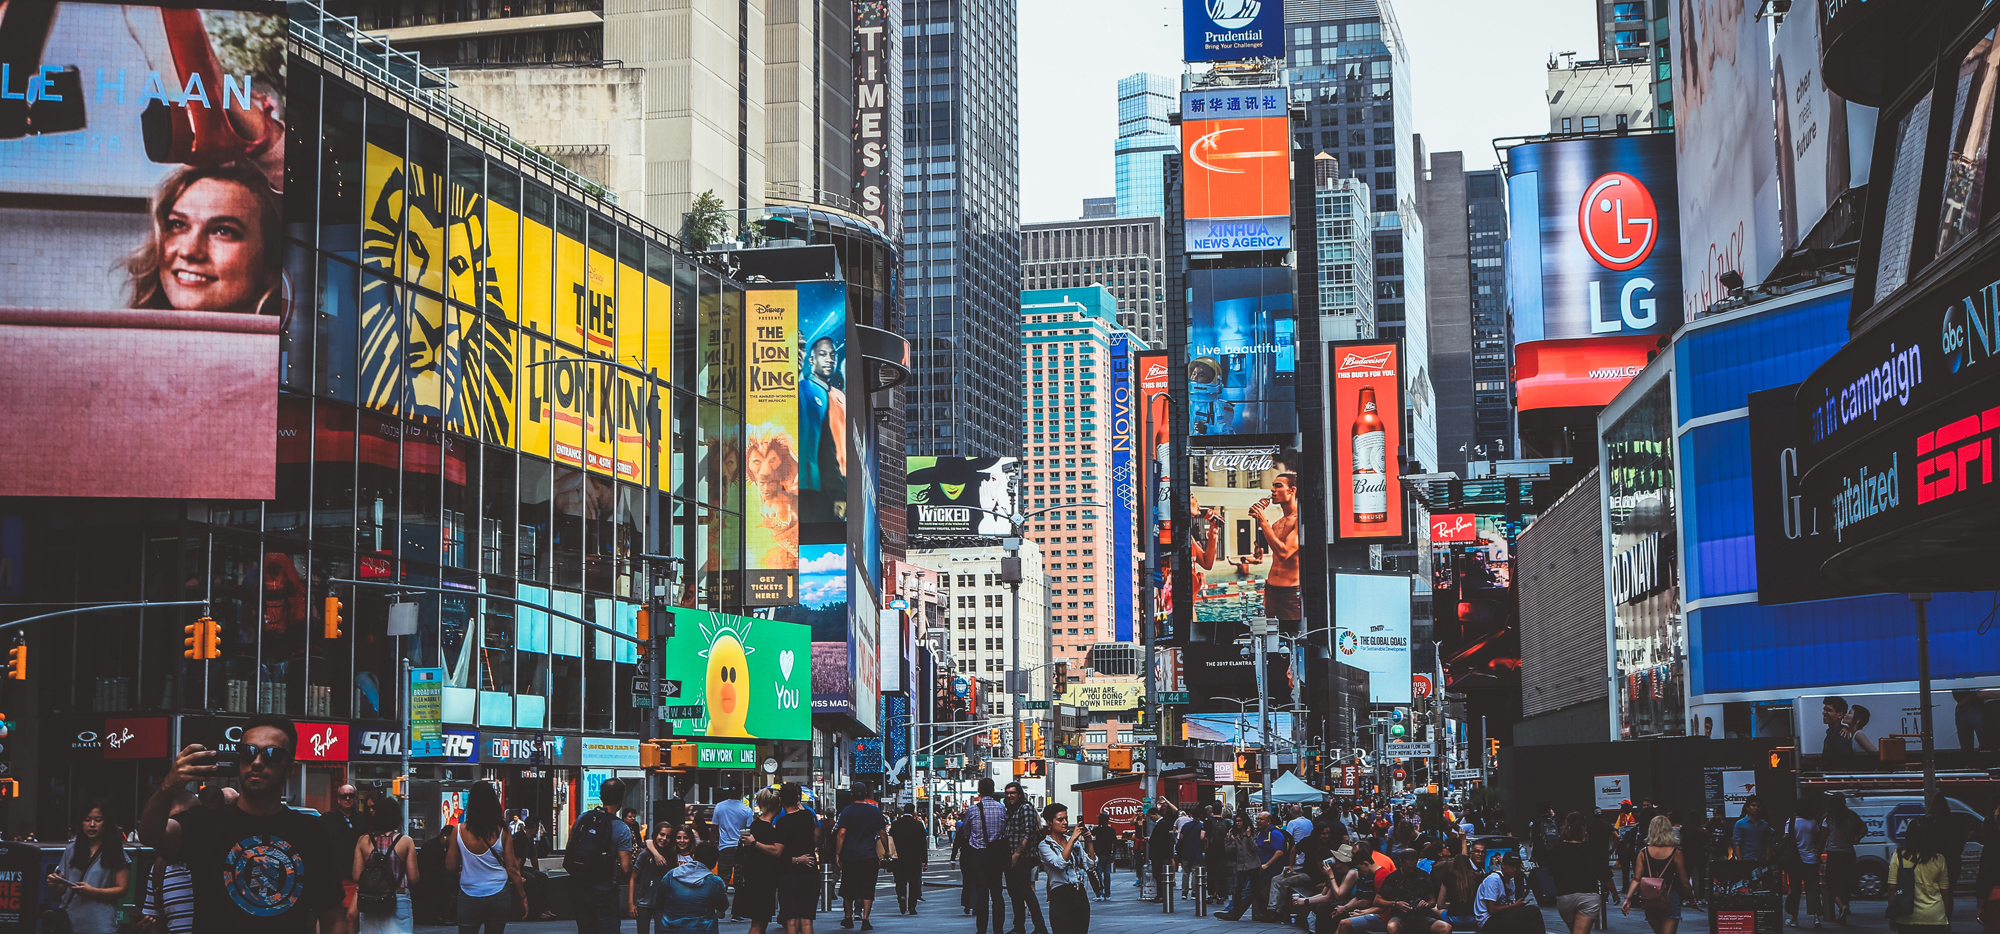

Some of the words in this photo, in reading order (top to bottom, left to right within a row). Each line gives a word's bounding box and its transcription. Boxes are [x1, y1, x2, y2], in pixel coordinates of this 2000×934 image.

[1205, 29, 1263, 42] Prudential
[1, 63, 64, 103] LE
[95, 68, 252, 111] HAAN
[1796, 69, 1811, 100] cher
[858, 26, 884, 168] TIMES
[1191, 95, 1277, 112] 新华通讯社
[1796, 125, 1817, 162] future
[1207, 223, 1269, 238] XINHUA
[1194, 237, 1230, 249] NEWS
[1232, 236, 1283, 248] AGENCY
[573, 282, 614, 338] THE
[754, 303, 785, 316] Disney
[1589, 277, 1657, 334] LG
[757, 326, 784, 339] THE
[1942, 322, 1964, 355] abc
[752, 342, 789, 364] LION
[1196, 345, 1221, 355] Live
[1225, 343, 1282, 355] beautiful
[529, 320, 595, 424] LION
[1344, 356, 1386, 366] Budweiser
[750, 366, 795, 392] KING
[1142, 381, 1155, 389] THIS
[1337, 371, 1351, 379] THIS
[1113, 346, 1130, 451] NOVOTEL
[1825, 388, 1838, 436] in
[1840, 343, 1923, 421] campaign
[556, 445, 582, 461] ENTRANCE
[588, 452, 597, 464] ON
[598, 454, 612, 468] 45TH
[617, 462, 632, 475] STREET
[1432, 516, 1473, 538] Ray-Ban
[1611, 550, 1630, 606] OLD
[1630, 531, 1659, 598] NAVY
[751, 584, 784, 592] TICKETS
[1360, 636, 1370, 645] THE
[1370, 636, 1389, 646] GLOBAL
[1390, 637, 1407, 646] GOALS
[774, 680, 799, 710] YOU
[1159, 692, 1166, 702] W
[1168, 692, 1179, 702] 44
[670, 707, 678, 717] W
[682, 707, 692, 717] 44
[673, 719, 683, 728] ALLY
[106, 727, 135, 749] Ray-Ban
[310, 727, 338, 757] Ray-Ban
[700, 749, 716, 761] NEW
[716, 750, 733, 762] YORK
[740, 750, 754, 763] LINE
[1345, 766, 1356, 786] tkts
